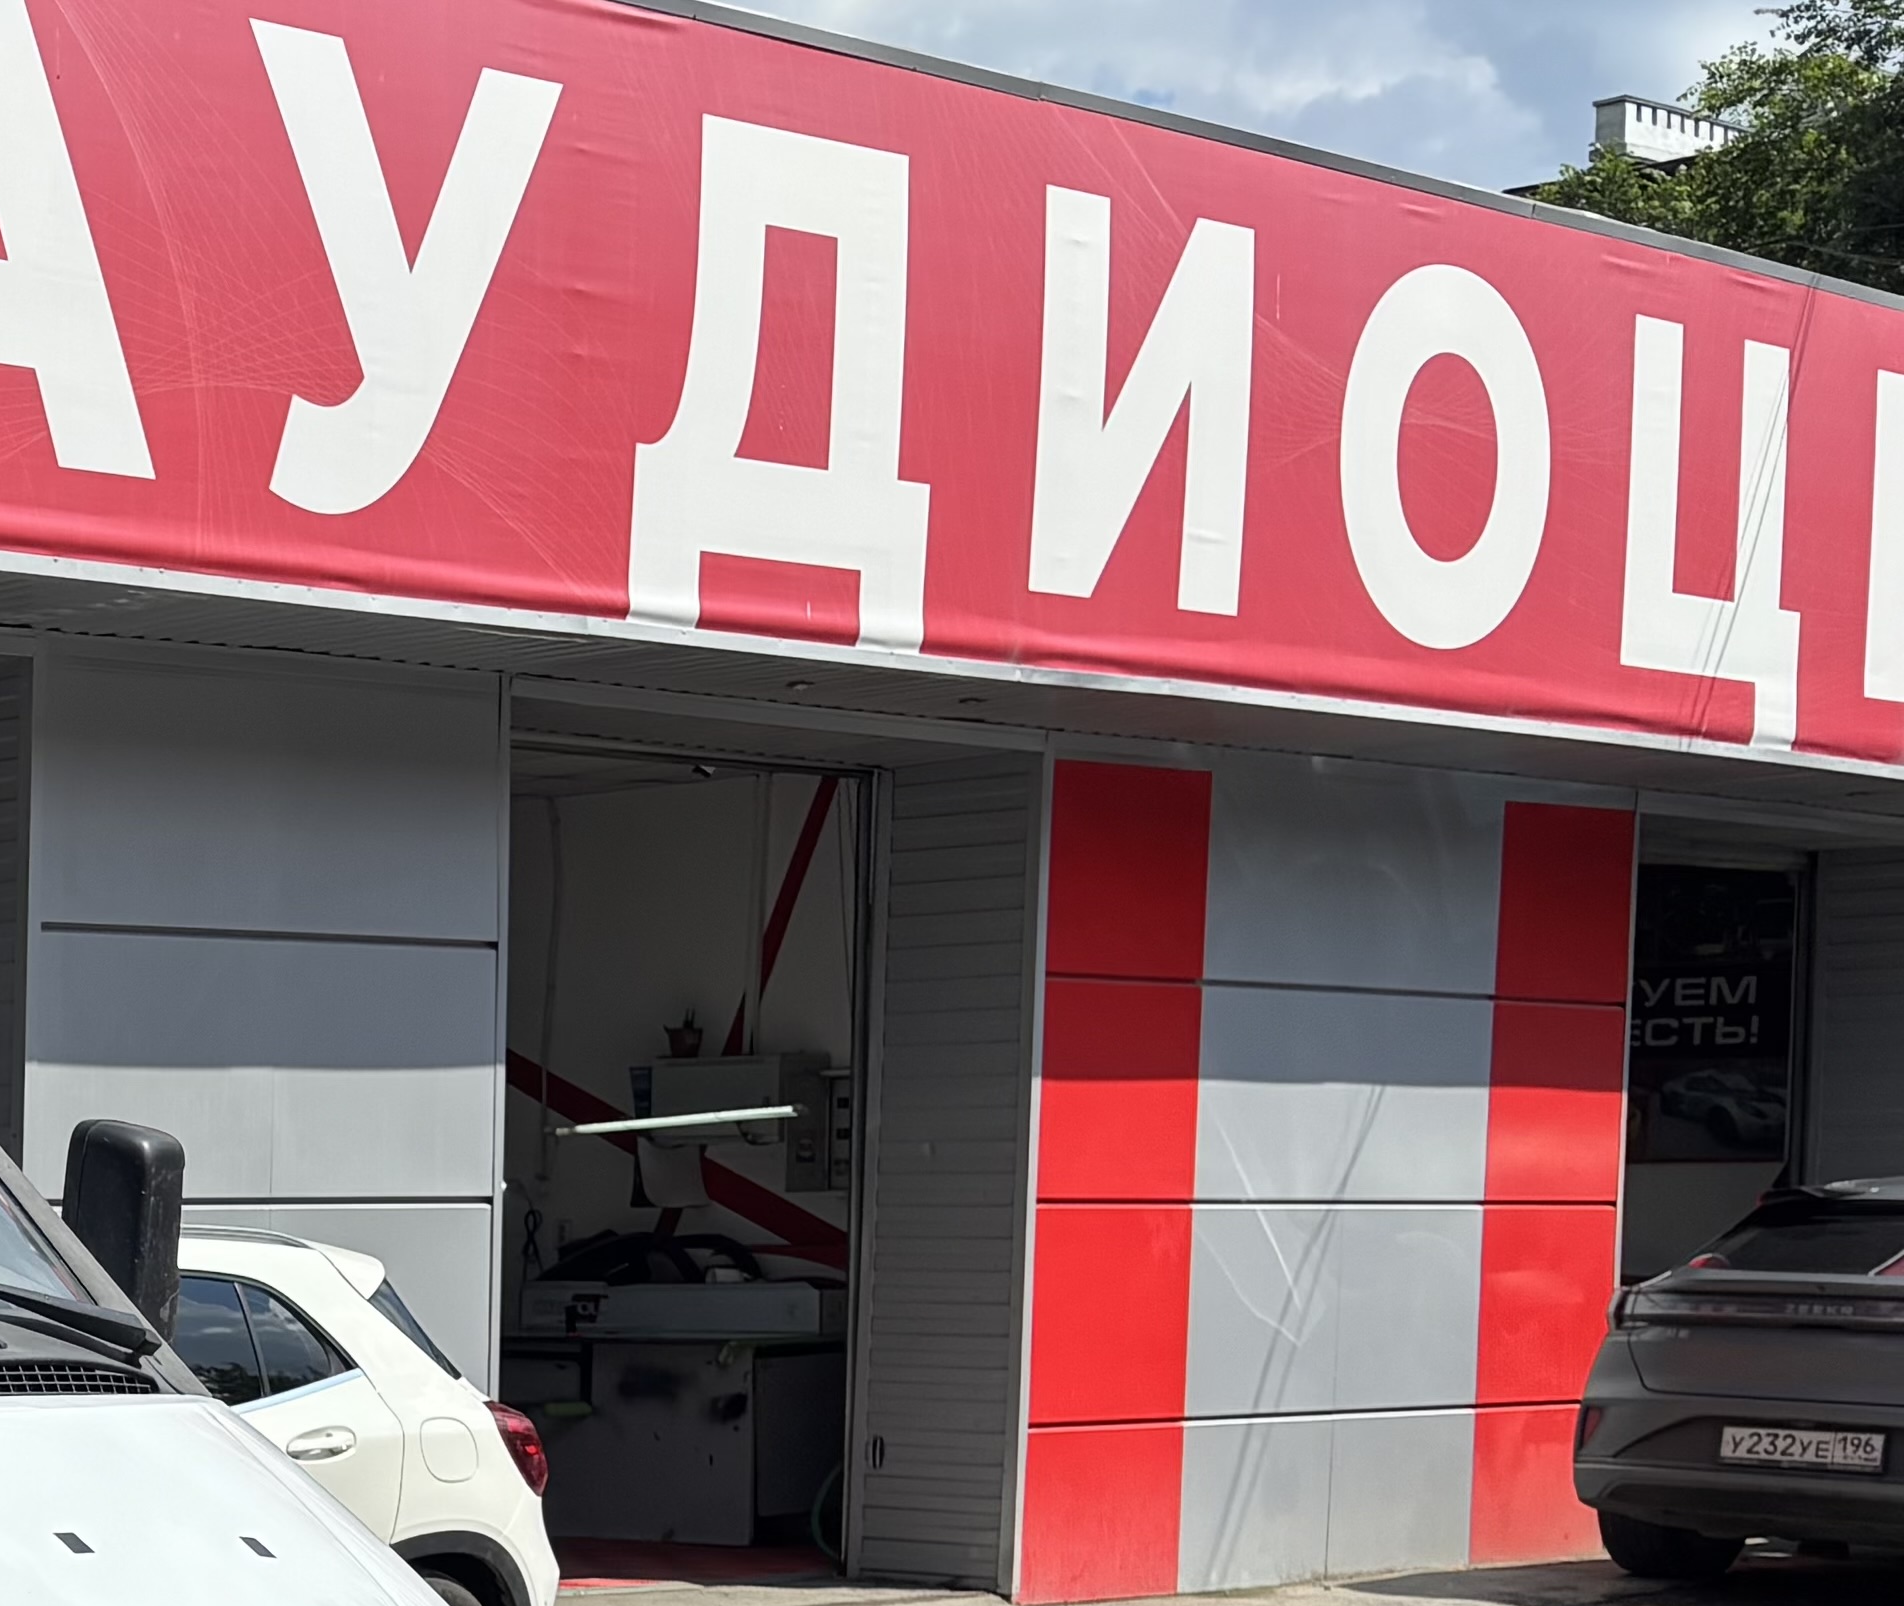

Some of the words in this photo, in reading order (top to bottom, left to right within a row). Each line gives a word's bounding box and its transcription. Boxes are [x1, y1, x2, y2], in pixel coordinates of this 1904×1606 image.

[1633, 975, 1758, 1008] УЕМ
[1730, 1431, 1831, 1460] У232УЕ
[1838, 1435, 1877, 1455] 196
